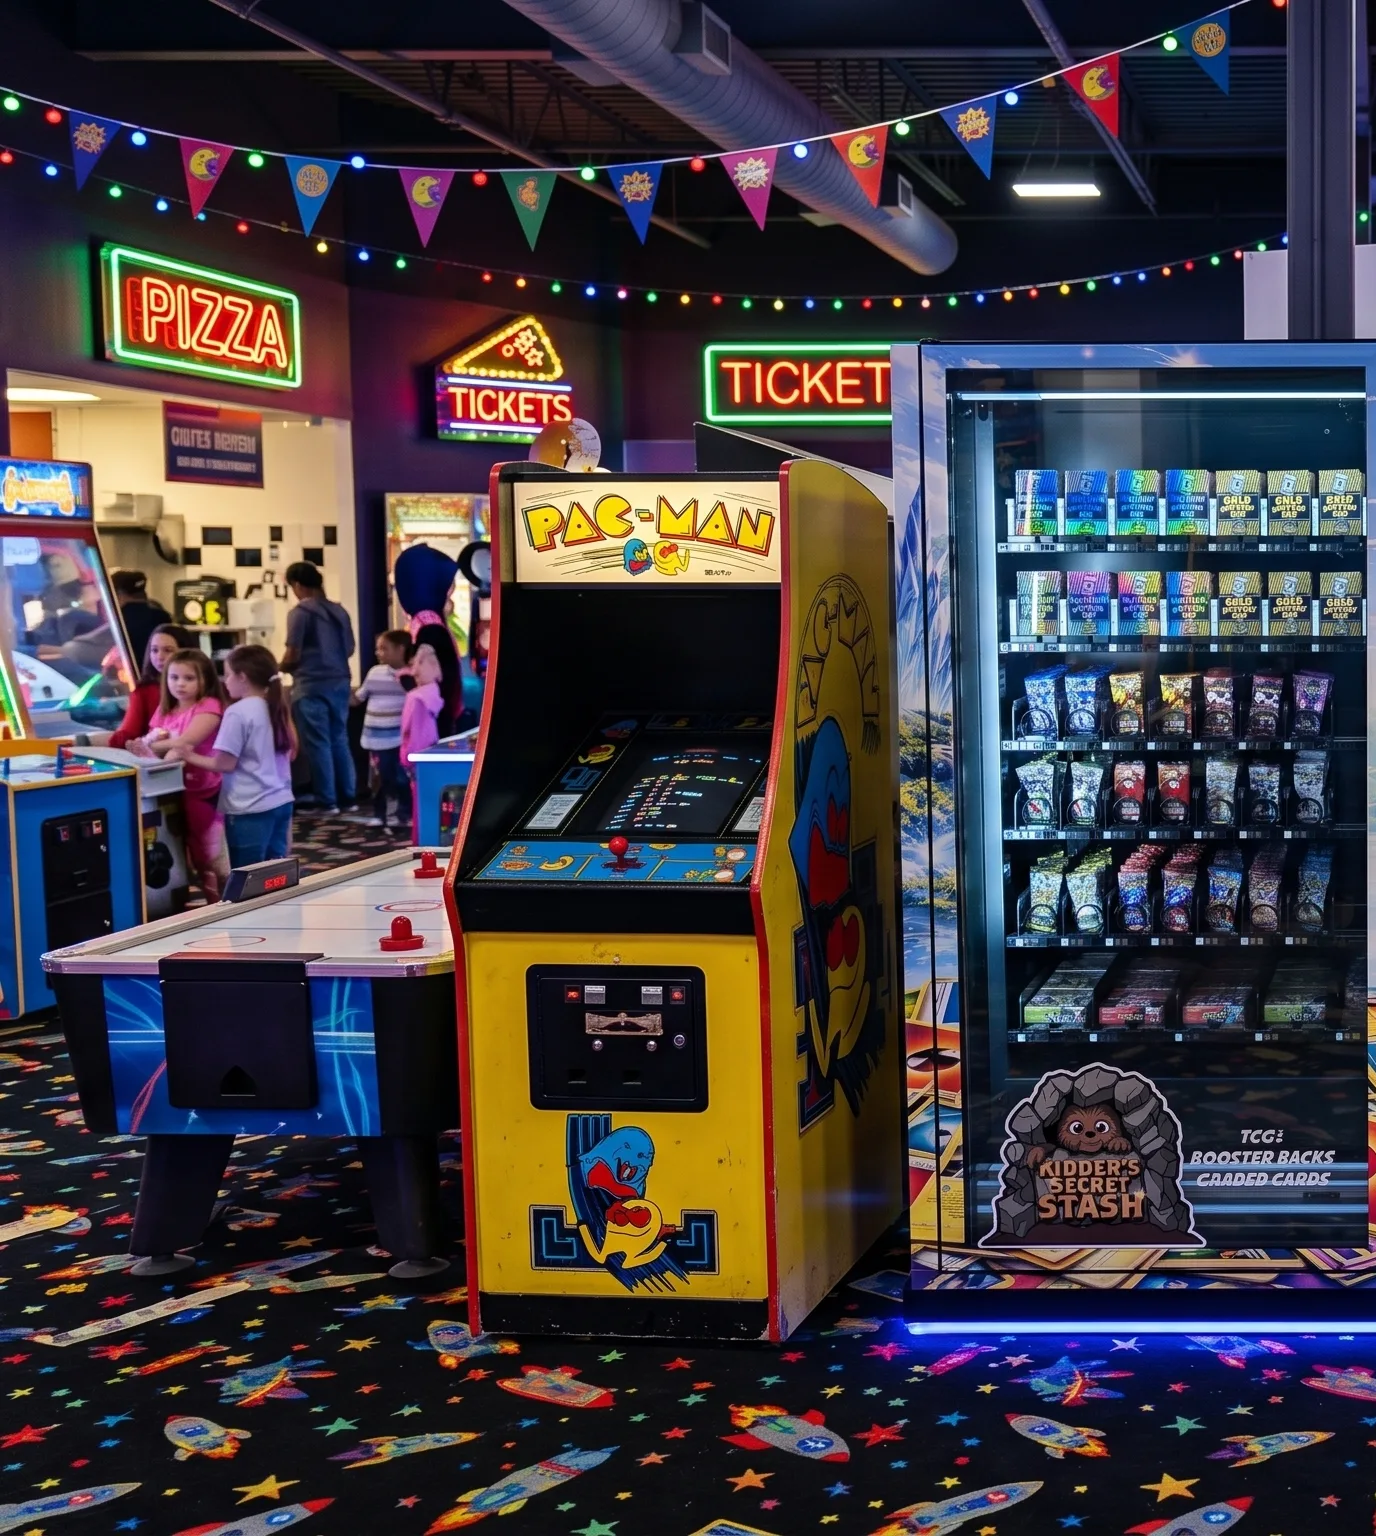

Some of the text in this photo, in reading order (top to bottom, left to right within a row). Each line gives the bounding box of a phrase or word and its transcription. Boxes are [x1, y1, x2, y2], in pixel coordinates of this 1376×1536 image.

[141, 275, 288, 368] PIZZA
[448, 386, 572, 425] TICKETS
[521, 493, 776, 556] PAC-MAN
[1039, 1158, 1141, 1177] KIDDER'S
[1190, 1150, 1336, 1165] BOOSTER BACKS
[1050, 1176, 1130, 1193] SECRET
[1271, 1171, 1331, 1187] CARDS
[1038, 1193, 1144, 1219] STASH
